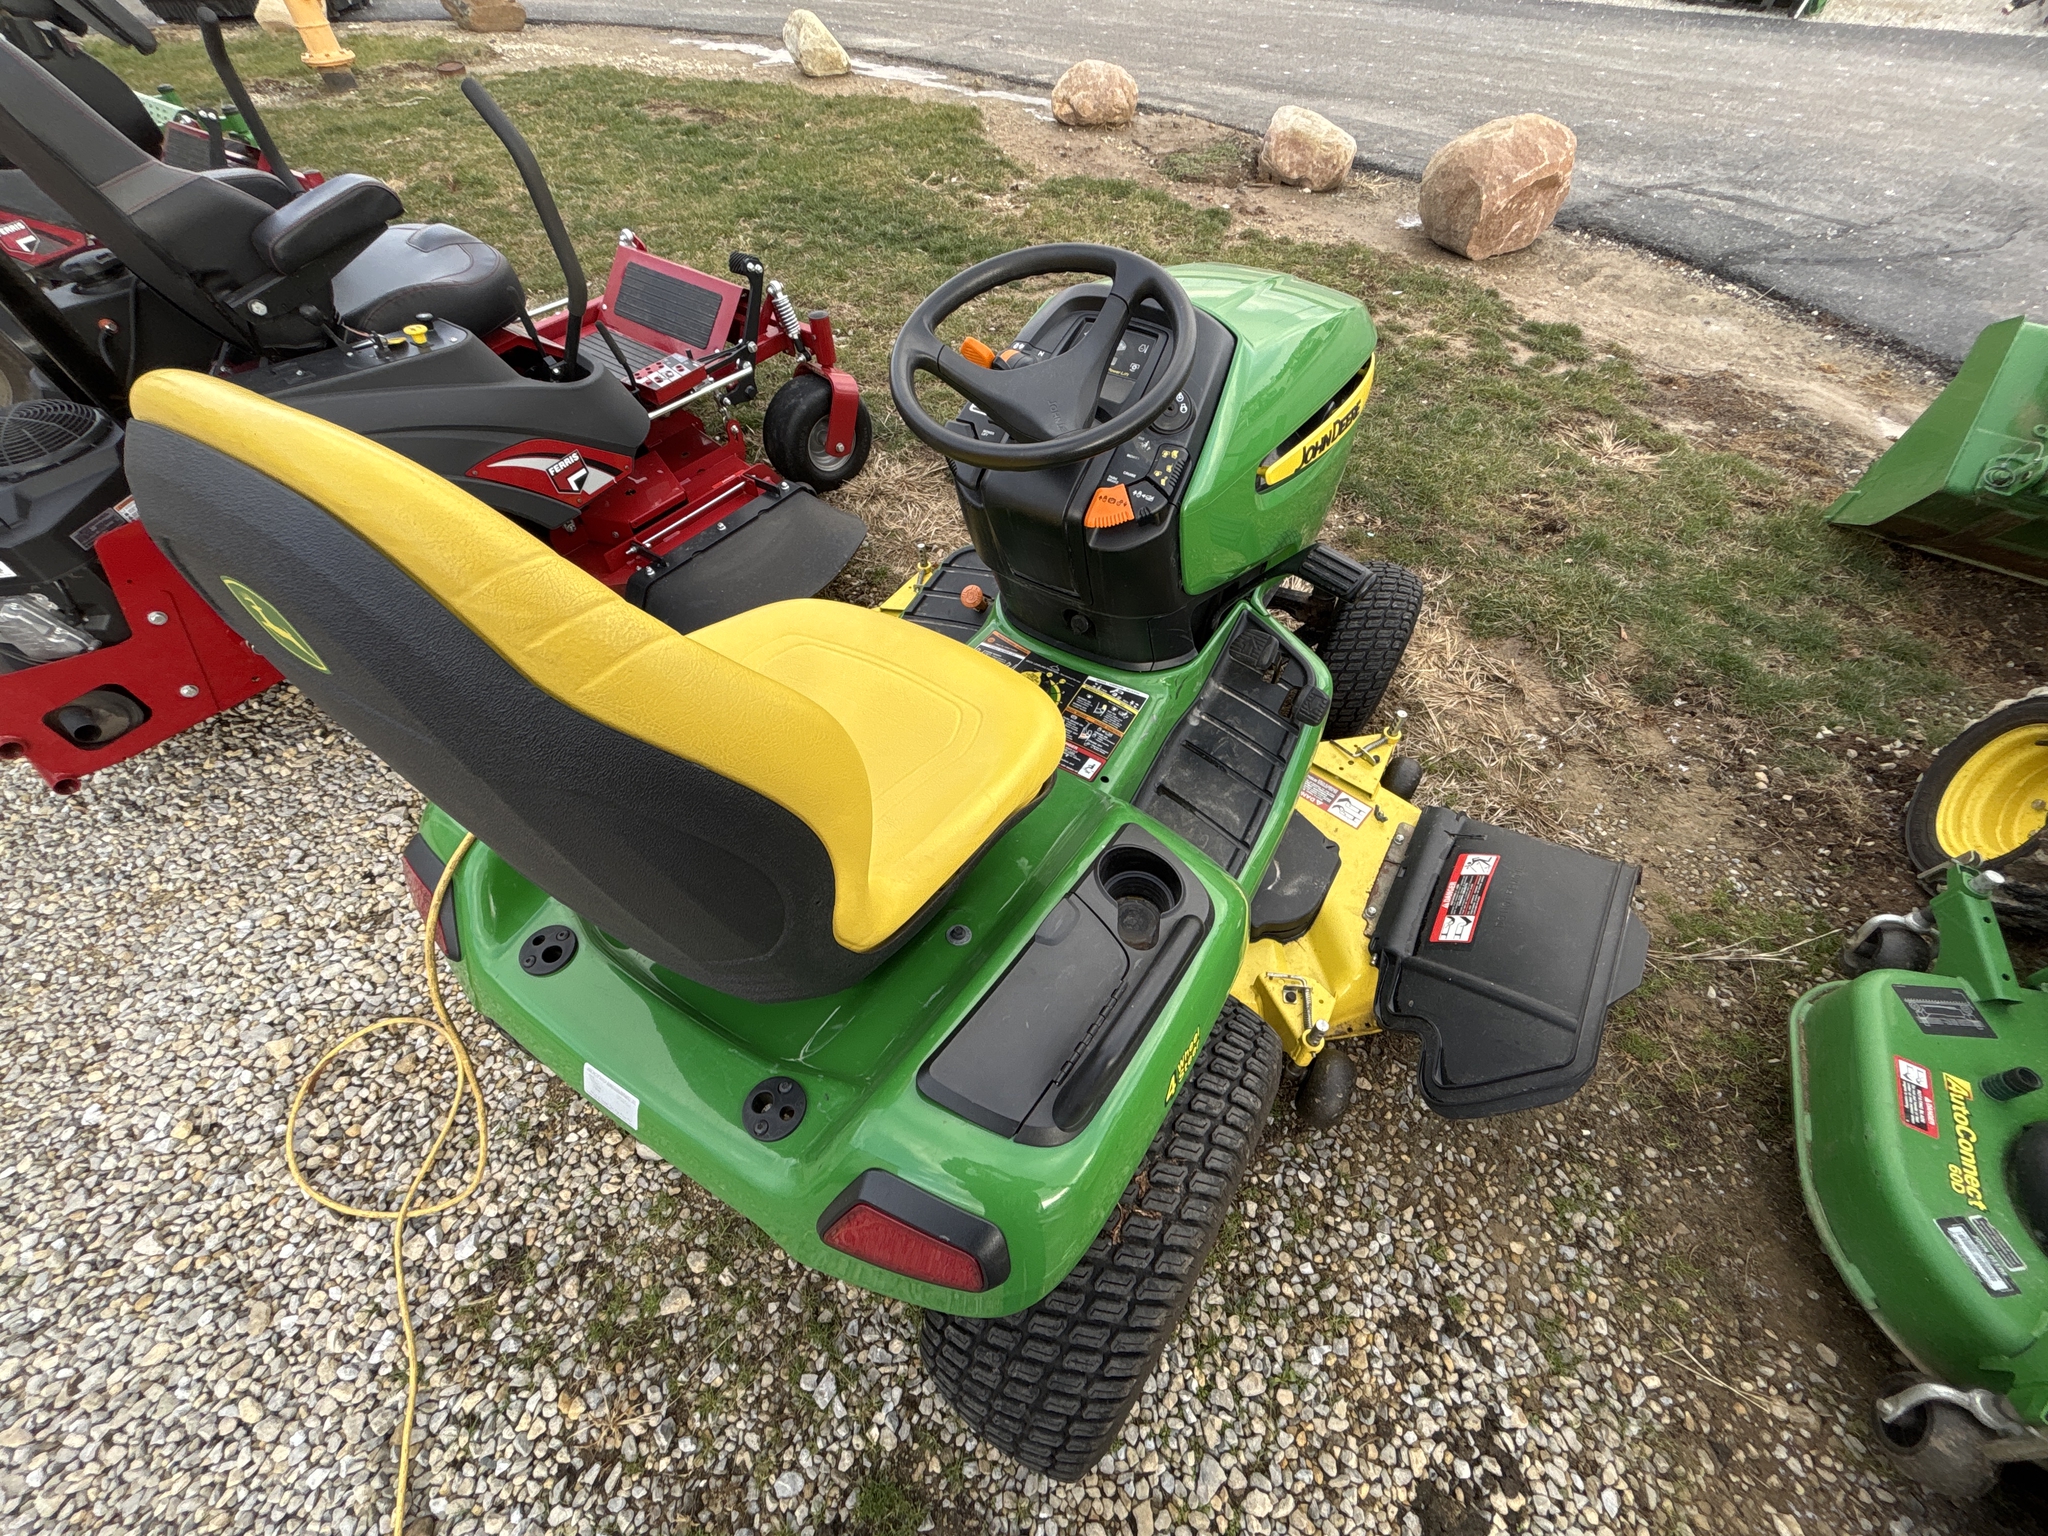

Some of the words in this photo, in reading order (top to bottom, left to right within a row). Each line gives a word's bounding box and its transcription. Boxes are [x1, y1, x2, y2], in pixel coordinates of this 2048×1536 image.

[0, 221, 25, 235] ERRIS
[1294, 429, 1332, 472] JOHN
[1331, 399, 1361, 443] DEERE
[548, 452, 580, 477] FERRIS
[1300, 791, 1315, 802] DAN
[1443, 881, 1457, 903] DANGER
[1177, 1026, 1200, 1072] Wheel
[1165, 1073, 1177, 1103] 4
[1942, 1071, 1989, 1212] AutoConnect
[1947, 1162, 1966, 1196] 60D
